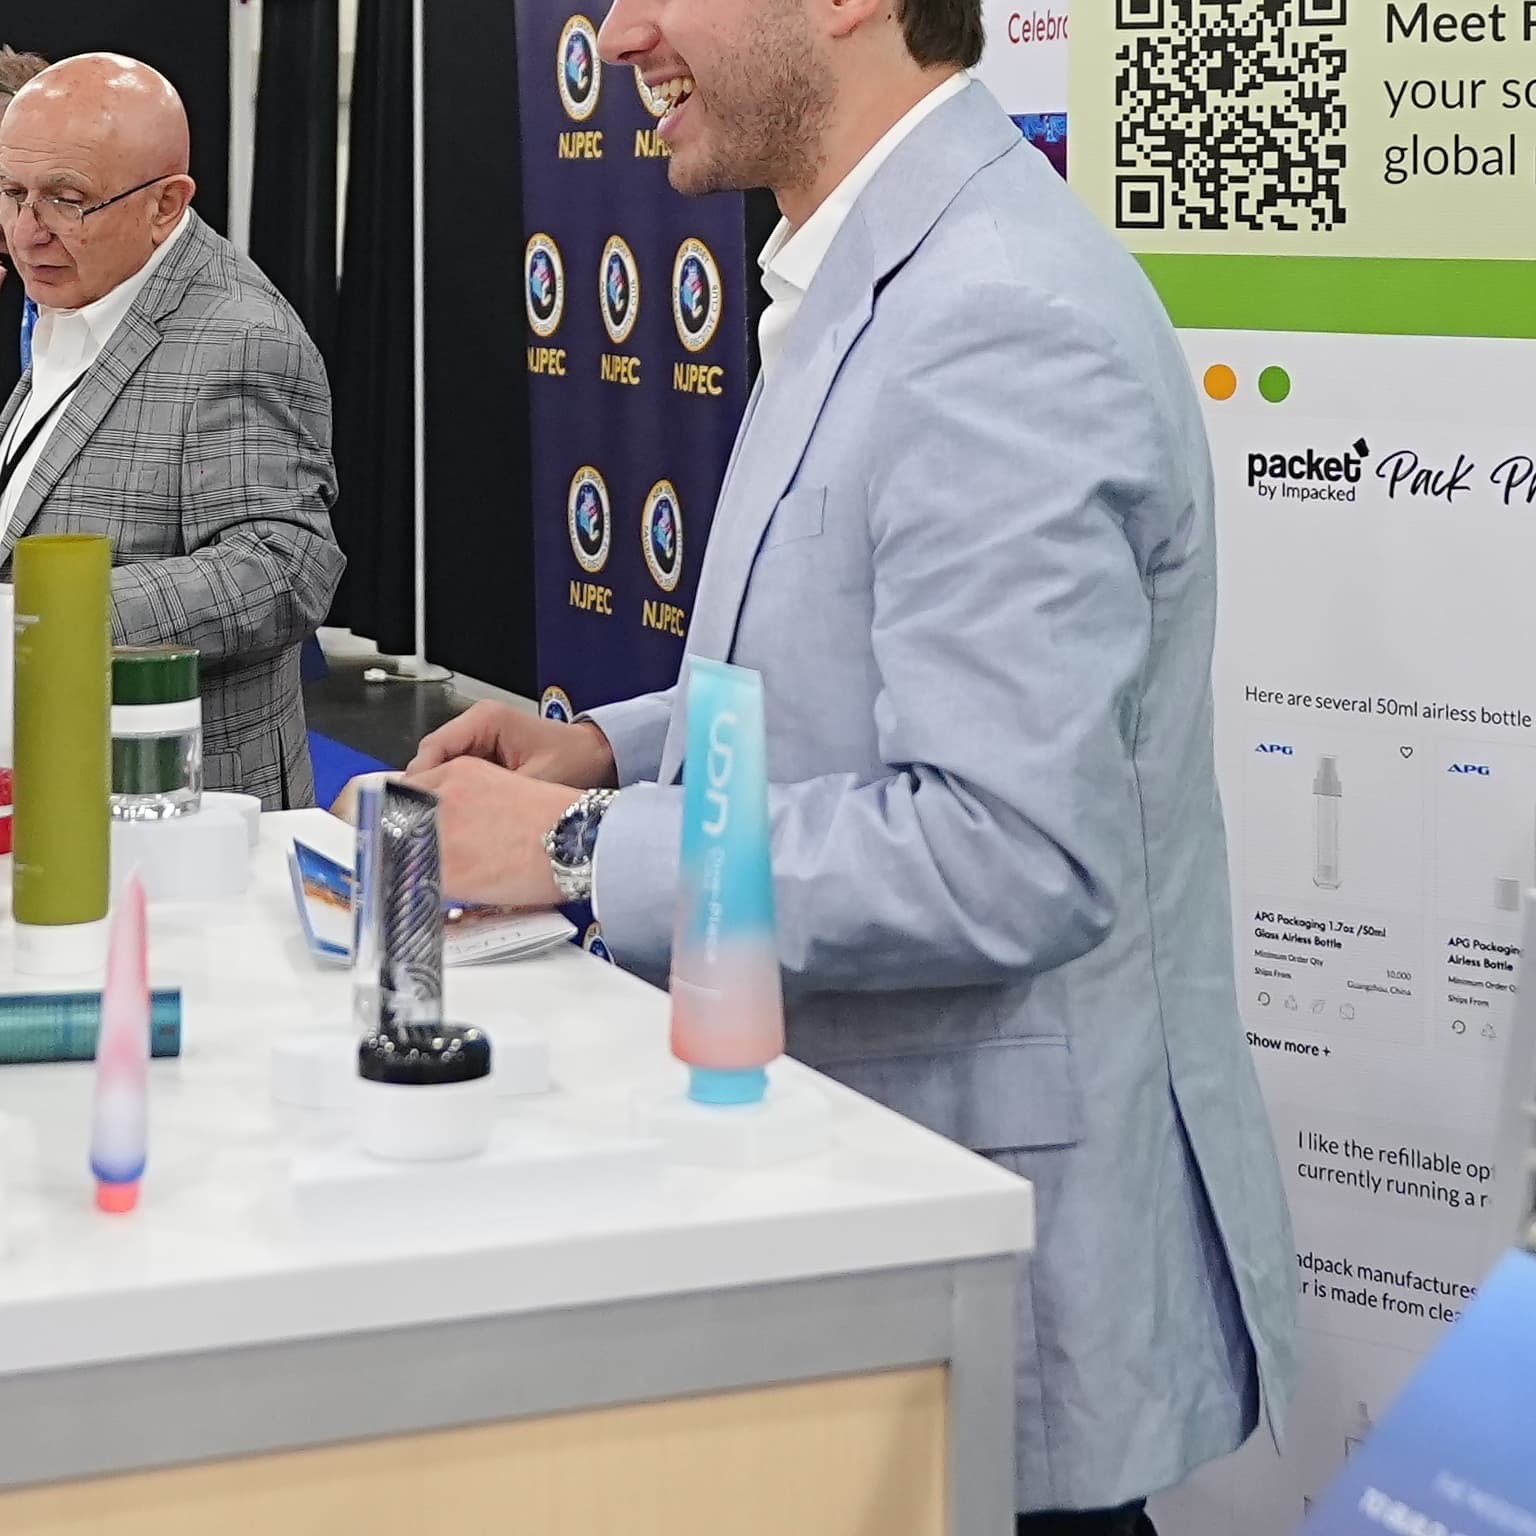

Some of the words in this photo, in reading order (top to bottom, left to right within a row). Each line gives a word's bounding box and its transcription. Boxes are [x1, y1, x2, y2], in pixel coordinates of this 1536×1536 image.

[1384, 1, 1505, 43] Meet
[1383, 75, 1486, 117] your
[559, 131, 603, 159] NJPEC
[1383, 134, 1516, 185] global
[601, 353, 641, 385] NJPEC
[673, 363, 724, 396] NJPEC
[1248, 448, 1362, 487] packet
[1375, 450, 1475, 504] Pack
[1258, 481, 1277, 498] by
[1282, 482, 1356, 503] Impacked
[569, 580, 613, 615] NJPEC
[642, 599, 685, 637] NJPEC
[1245, 686, 1284, 705] Here
[1287, 694, 1312, 708] are
[1315, 696, 1372, 714] several
[1376, 697, 1418, 718] 50ml
[1422, 703, 1476, 723] airless
[1480, 706, 1531, 728] bottle
[1254, 743, 1294, 756] APG
[1447, 763, 1490, 776] APG
[1254, 910, 1275, 923] APG
[1277, 913, 1326, 933] Packaging
[1282, 929, 1312, 945] Airless
[1314, 935, 1342, 950] Bottle
[1448, 936, 1470, 949] APG
[1448, 954, 1481, 969] Airless
[1483, 958, 1514, 973] Bottle
[1448, 975, 1484, 989] Minimum
[1485, 980, 1508, 993] Order
[1448, 994, 1468, 1007] Ships
[1469, 997, 1490, 1008] From
[1246, 1031, 1282, 1051] Show
[1284, 1041, 1320, 1057] more
[1298, 1131, 1303, 1150] I
[1308, 1131, 1339, 1155] like
[1344, 1139, 1374, 1162] the
[1378, 1147, 1461, 1176] refillable
[1297, 1162, 1382, 1194] currently
[1386, 1177, 1460, 1209] running
[1464, 1191, 1476, 1207] a
[1313, 1279, 1327, 1298] is
[1331, 1284, 1378, 1308] made
[1381, 1292, 1425, 1317] from
